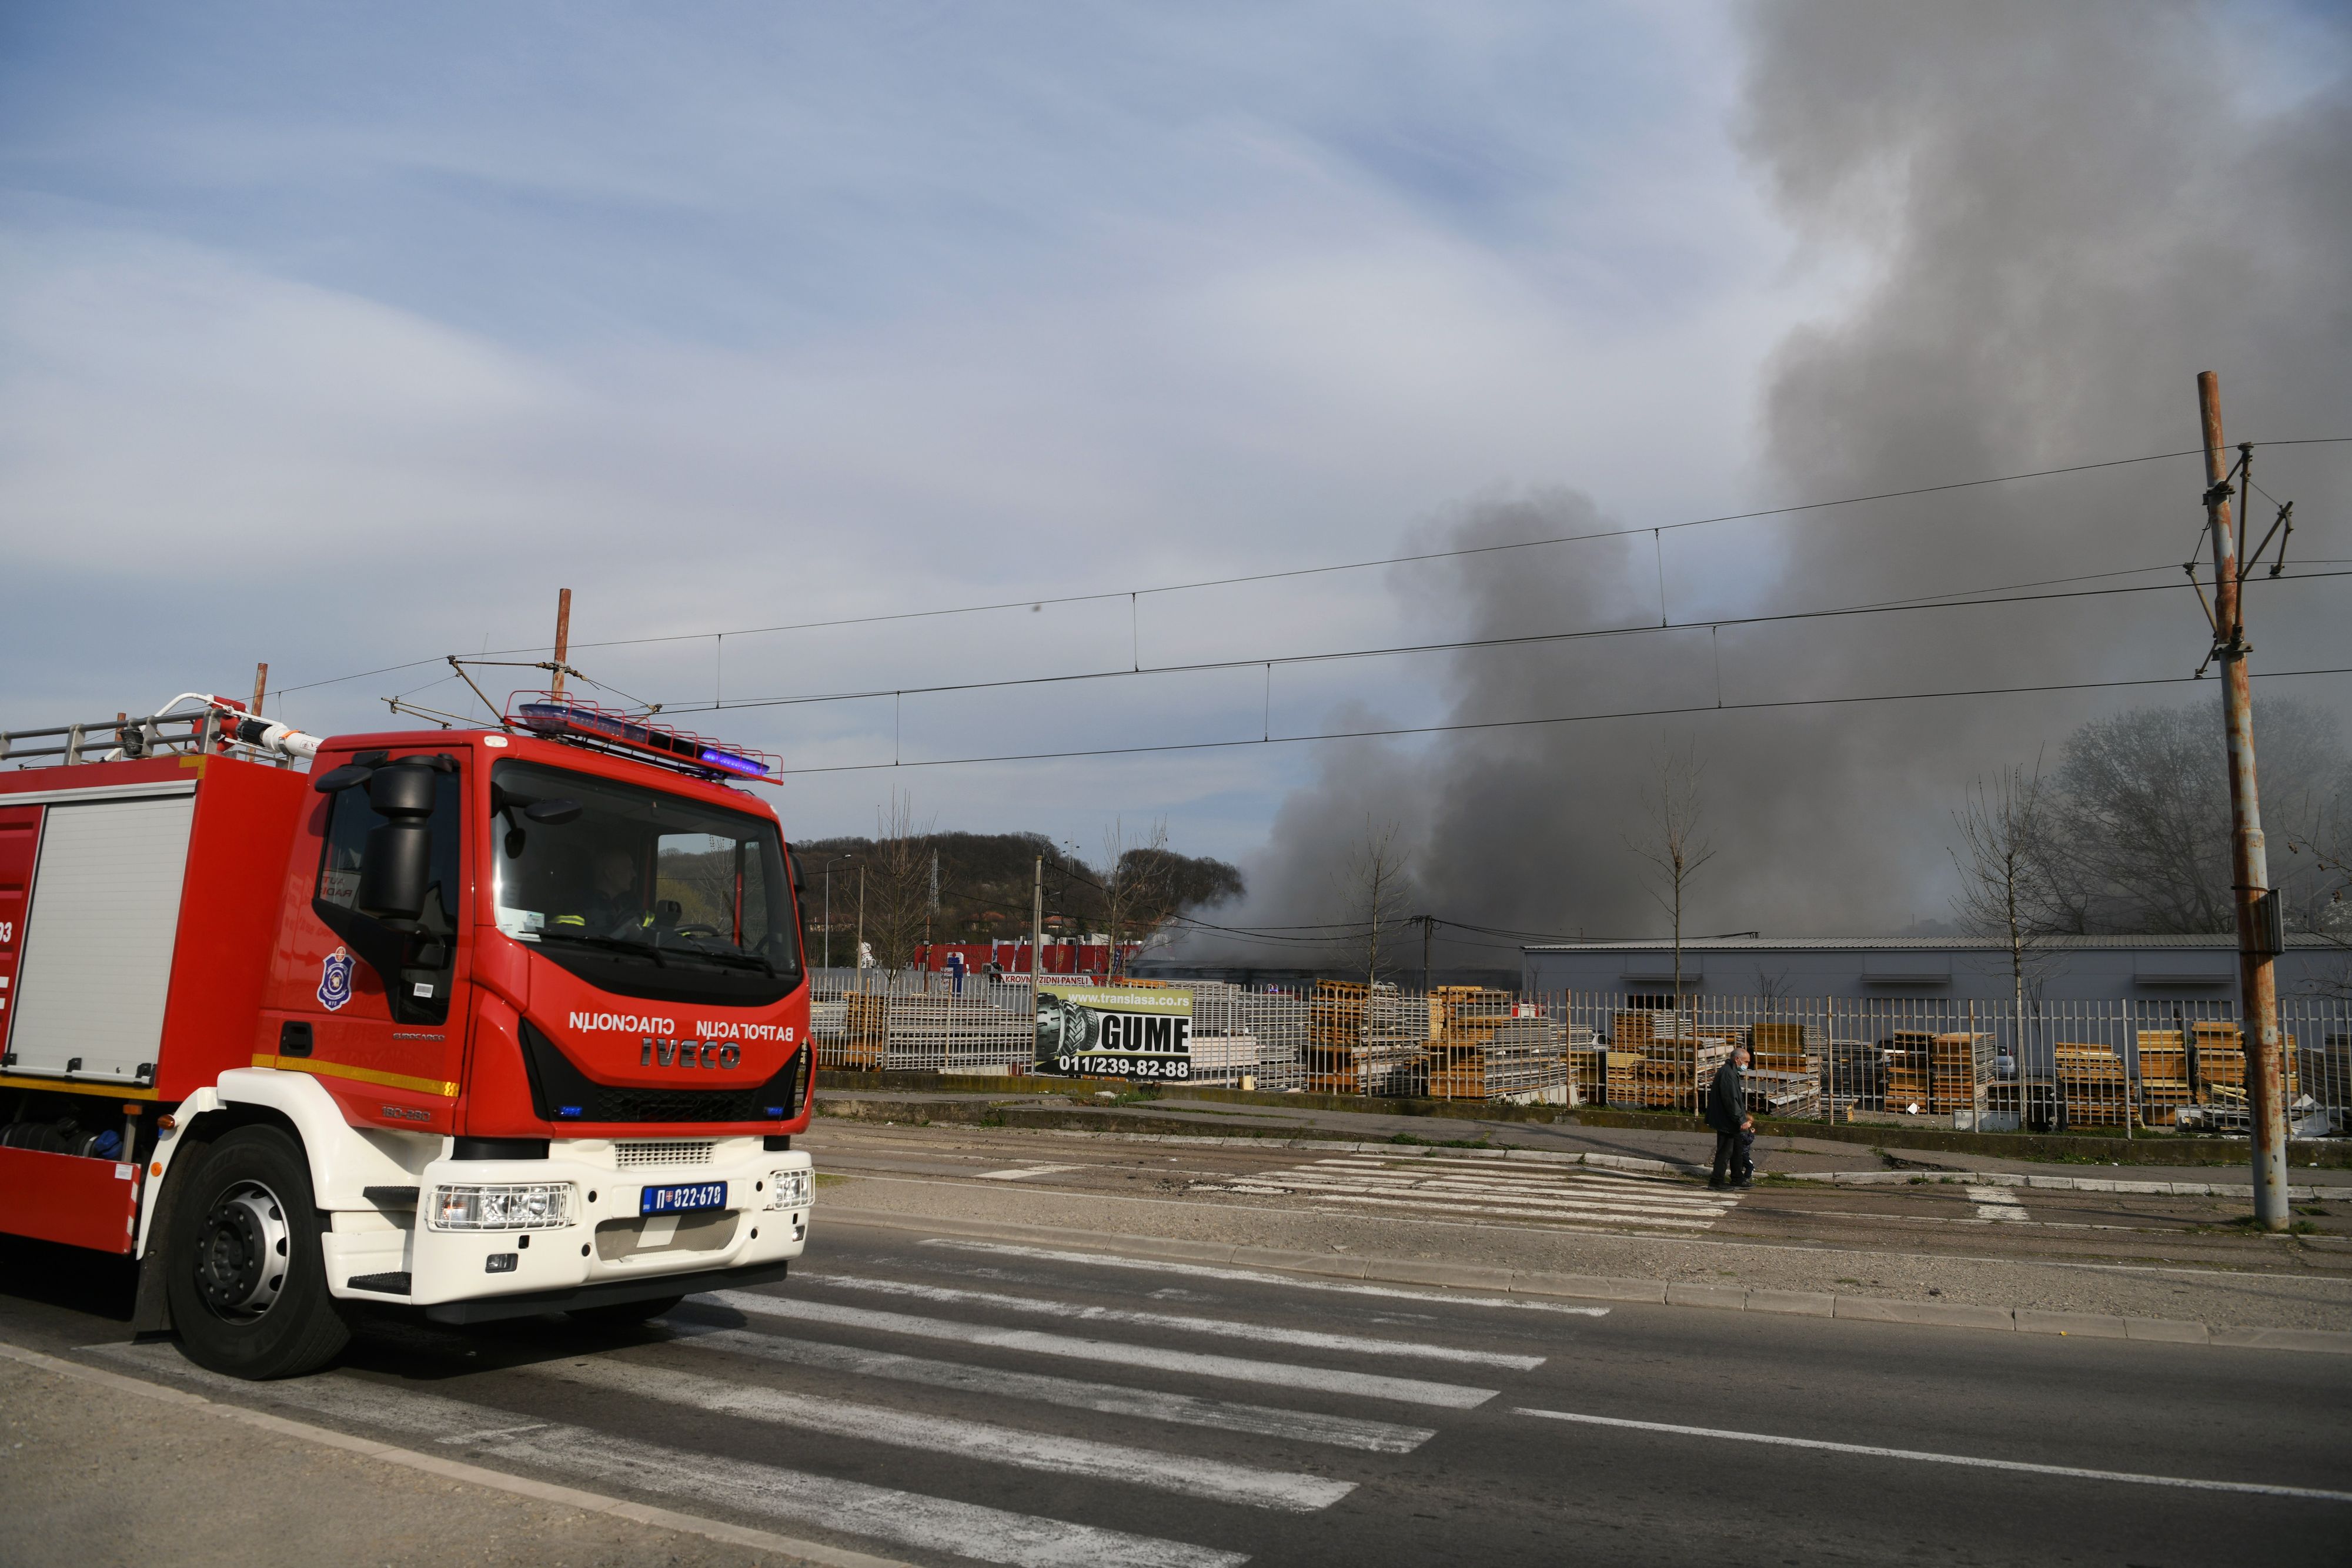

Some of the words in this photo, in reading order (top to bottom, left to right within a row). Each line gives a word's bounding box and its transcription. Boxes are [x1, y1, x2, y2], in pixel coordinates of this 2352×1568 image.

[1039, 976, 1059, 984] ZIDNI
[1068, 992, 1190, 1007] www.translasa.co.rs
[393, 1032, 445, 1042] EUROCARGO
[1101, 1015, 1189, 1054] GUME
[640, 1037, 741, 1069] IVECO
[1059, 1055, 1188, 1078] 011/239-82-88
